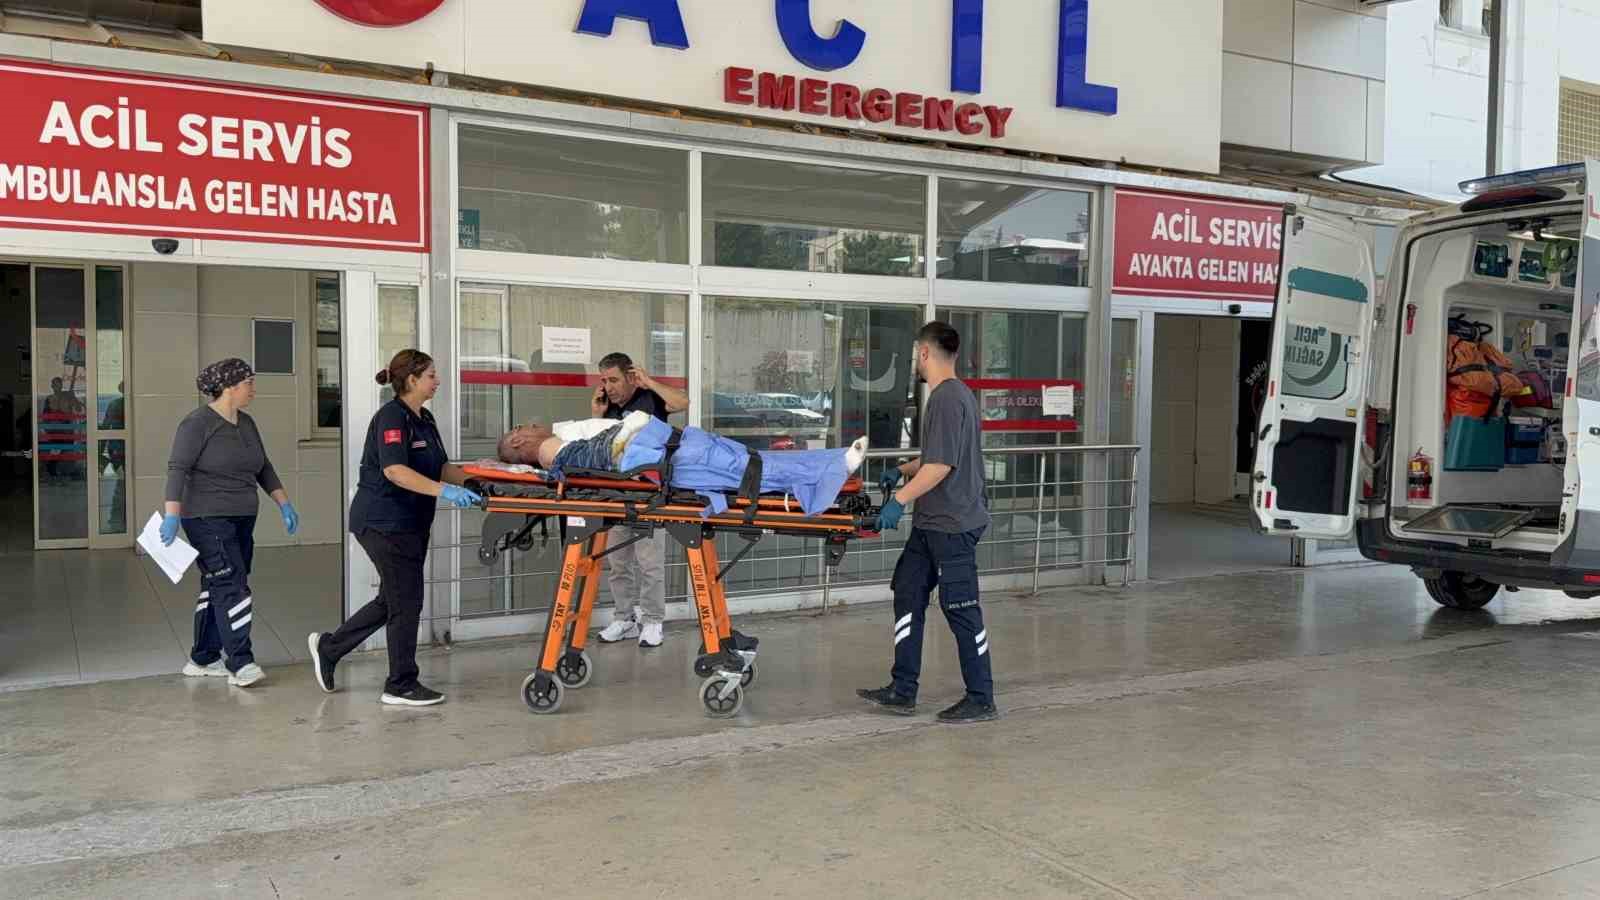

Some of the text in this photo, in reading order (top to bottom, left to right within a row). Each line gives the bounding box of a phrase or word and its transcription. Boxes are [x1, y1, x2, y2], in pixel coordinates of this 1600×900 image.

[39, 97, 352, 169] ACİL SERVİS
[724, 66, 1013, 138] EMERGENCY
[0, 164, 398, 226] MBULANSLA GELEN HASTA
[1151, 208, 1281, 250] ACİL SERVİS
[1128, 252, 1194, 280] AYAKTA
[1197, 258, 1249, 283] GELEN
